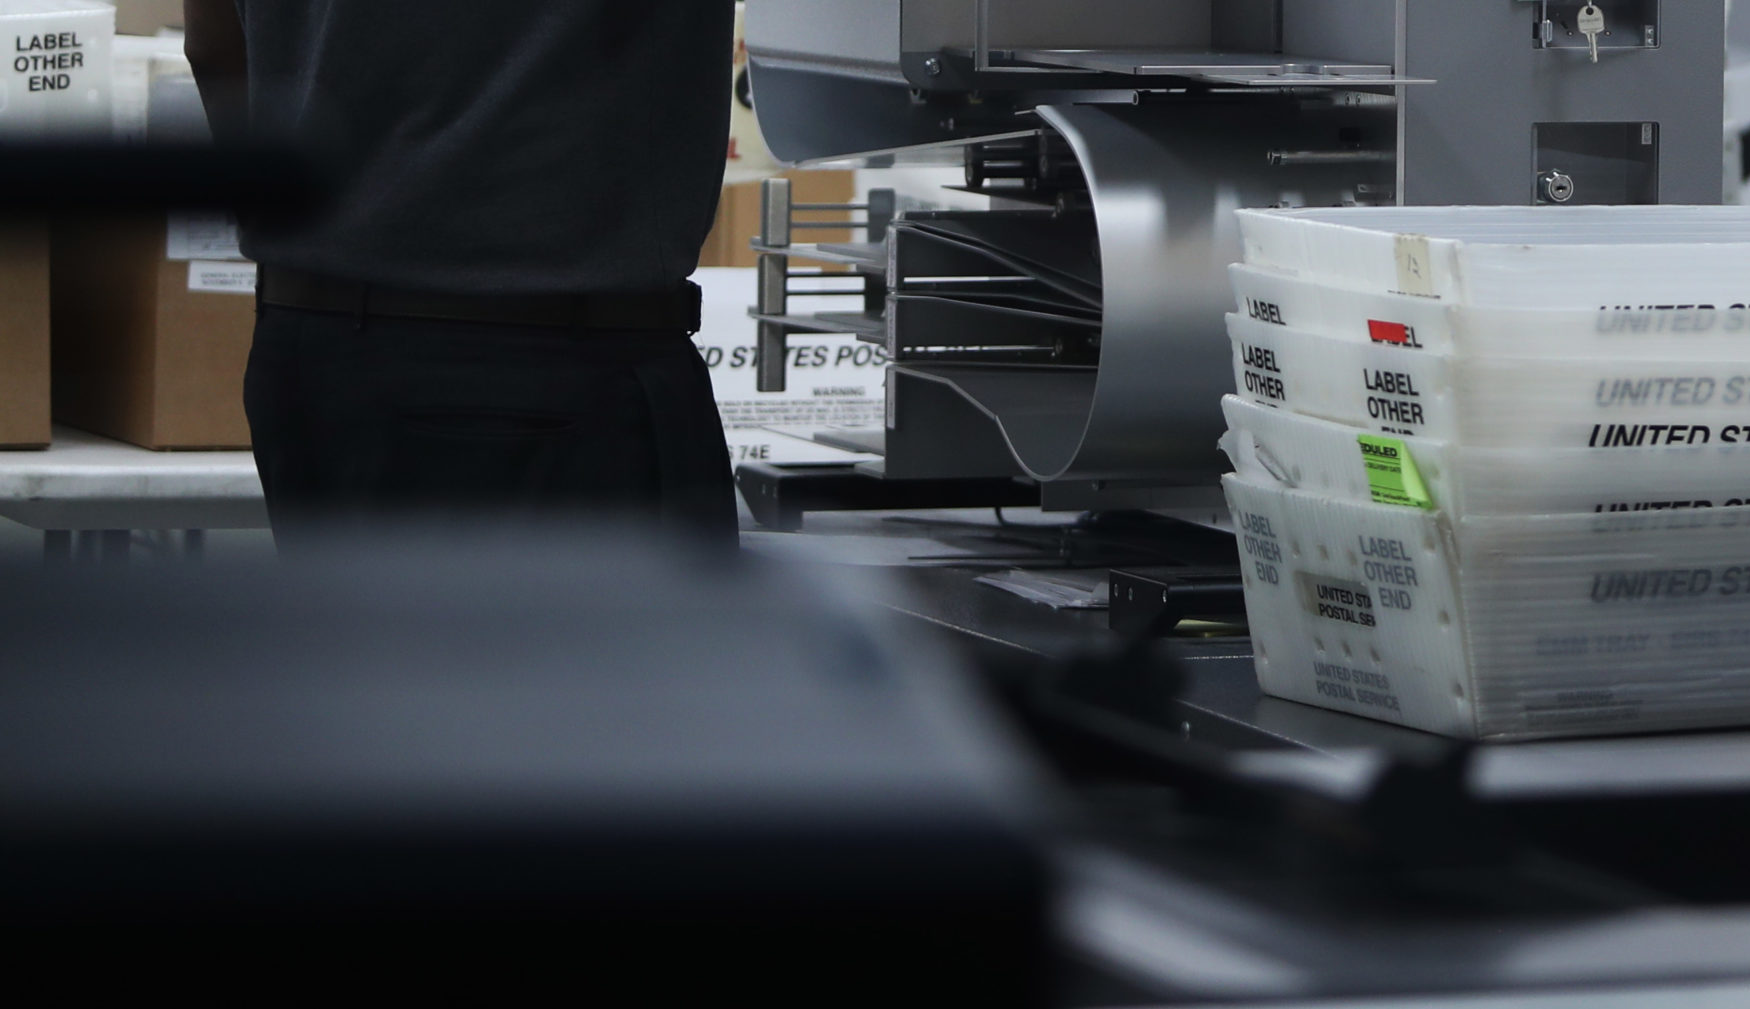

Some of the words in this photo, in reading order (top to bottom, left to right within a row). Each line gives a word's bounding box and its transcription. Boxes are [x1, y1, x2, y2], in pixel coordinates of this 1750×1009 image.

[16, 32, 82, 52] LABEL
[14, 52, 83, 73] OTHER
[28, 74, 71, 92] END
[1245, 296, 1287, 325] LABEL
[1240, 342, 1281, 372] LABEL
[1244, 370, 1286, 401] OTHER
[1363, 368, 1420, 397] LABEL
[1595, 376, 1716, 408] UNITED
[1367, 396, 1425, 425] OTHER
[739, 444, 771, 460] 74E
[1238, 510, 1278, 539] LABEL
[1244, 536, 1282, 563] OTHER
[1358, 535, 1412, 562] LABEL
[1255, 560, 1280, 585] END
[1364, 560, 1418, 587] OTHER
[1590, 567, 1713, 603] UNITED
[1316, 584, 1354, 606] UNITED
[1378, 586, 1413, 611] END
[1318, 603, 1358, 624] POSTAL
[1313, 661, 1351, 683] UNITED
[1351, 668, 1390, 690] STATES
[1316, 679, 1358, 701] POSTAL
